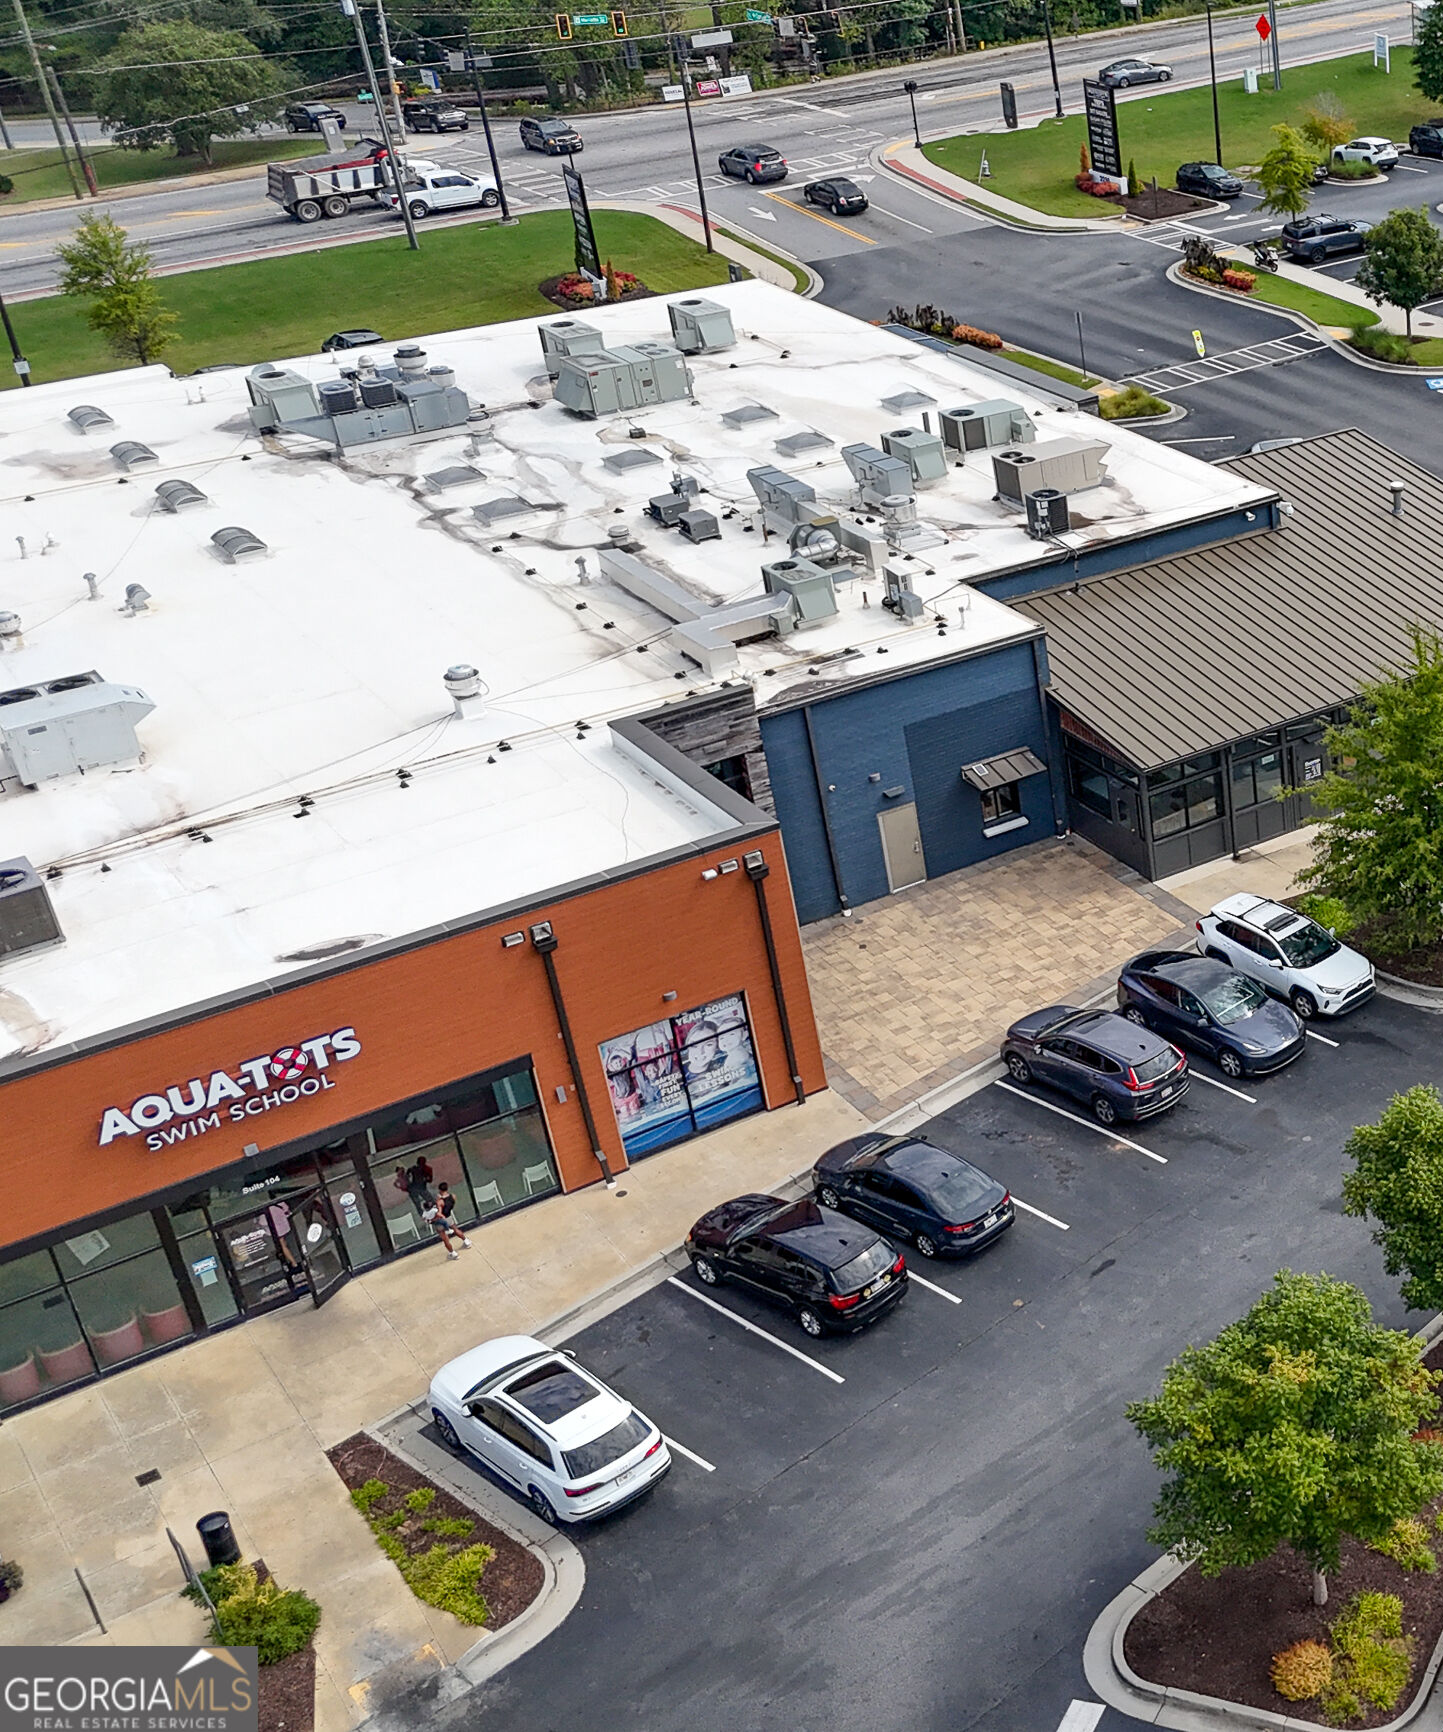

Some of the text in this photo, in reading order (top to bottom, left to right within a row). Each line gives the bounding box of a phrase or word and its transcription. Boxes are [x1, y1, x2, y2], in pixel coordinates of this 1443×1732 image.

[675, 997, 738, 1026] YEAR-ROUND
[98, 1026, 362, 1146] AQUA-TOTS
[660, 1084, 681, 1098] FUN
[146, 1074, 336, 1151] SWIM SCHOOL
[242, 1175, 280, 1195] Suite 104
